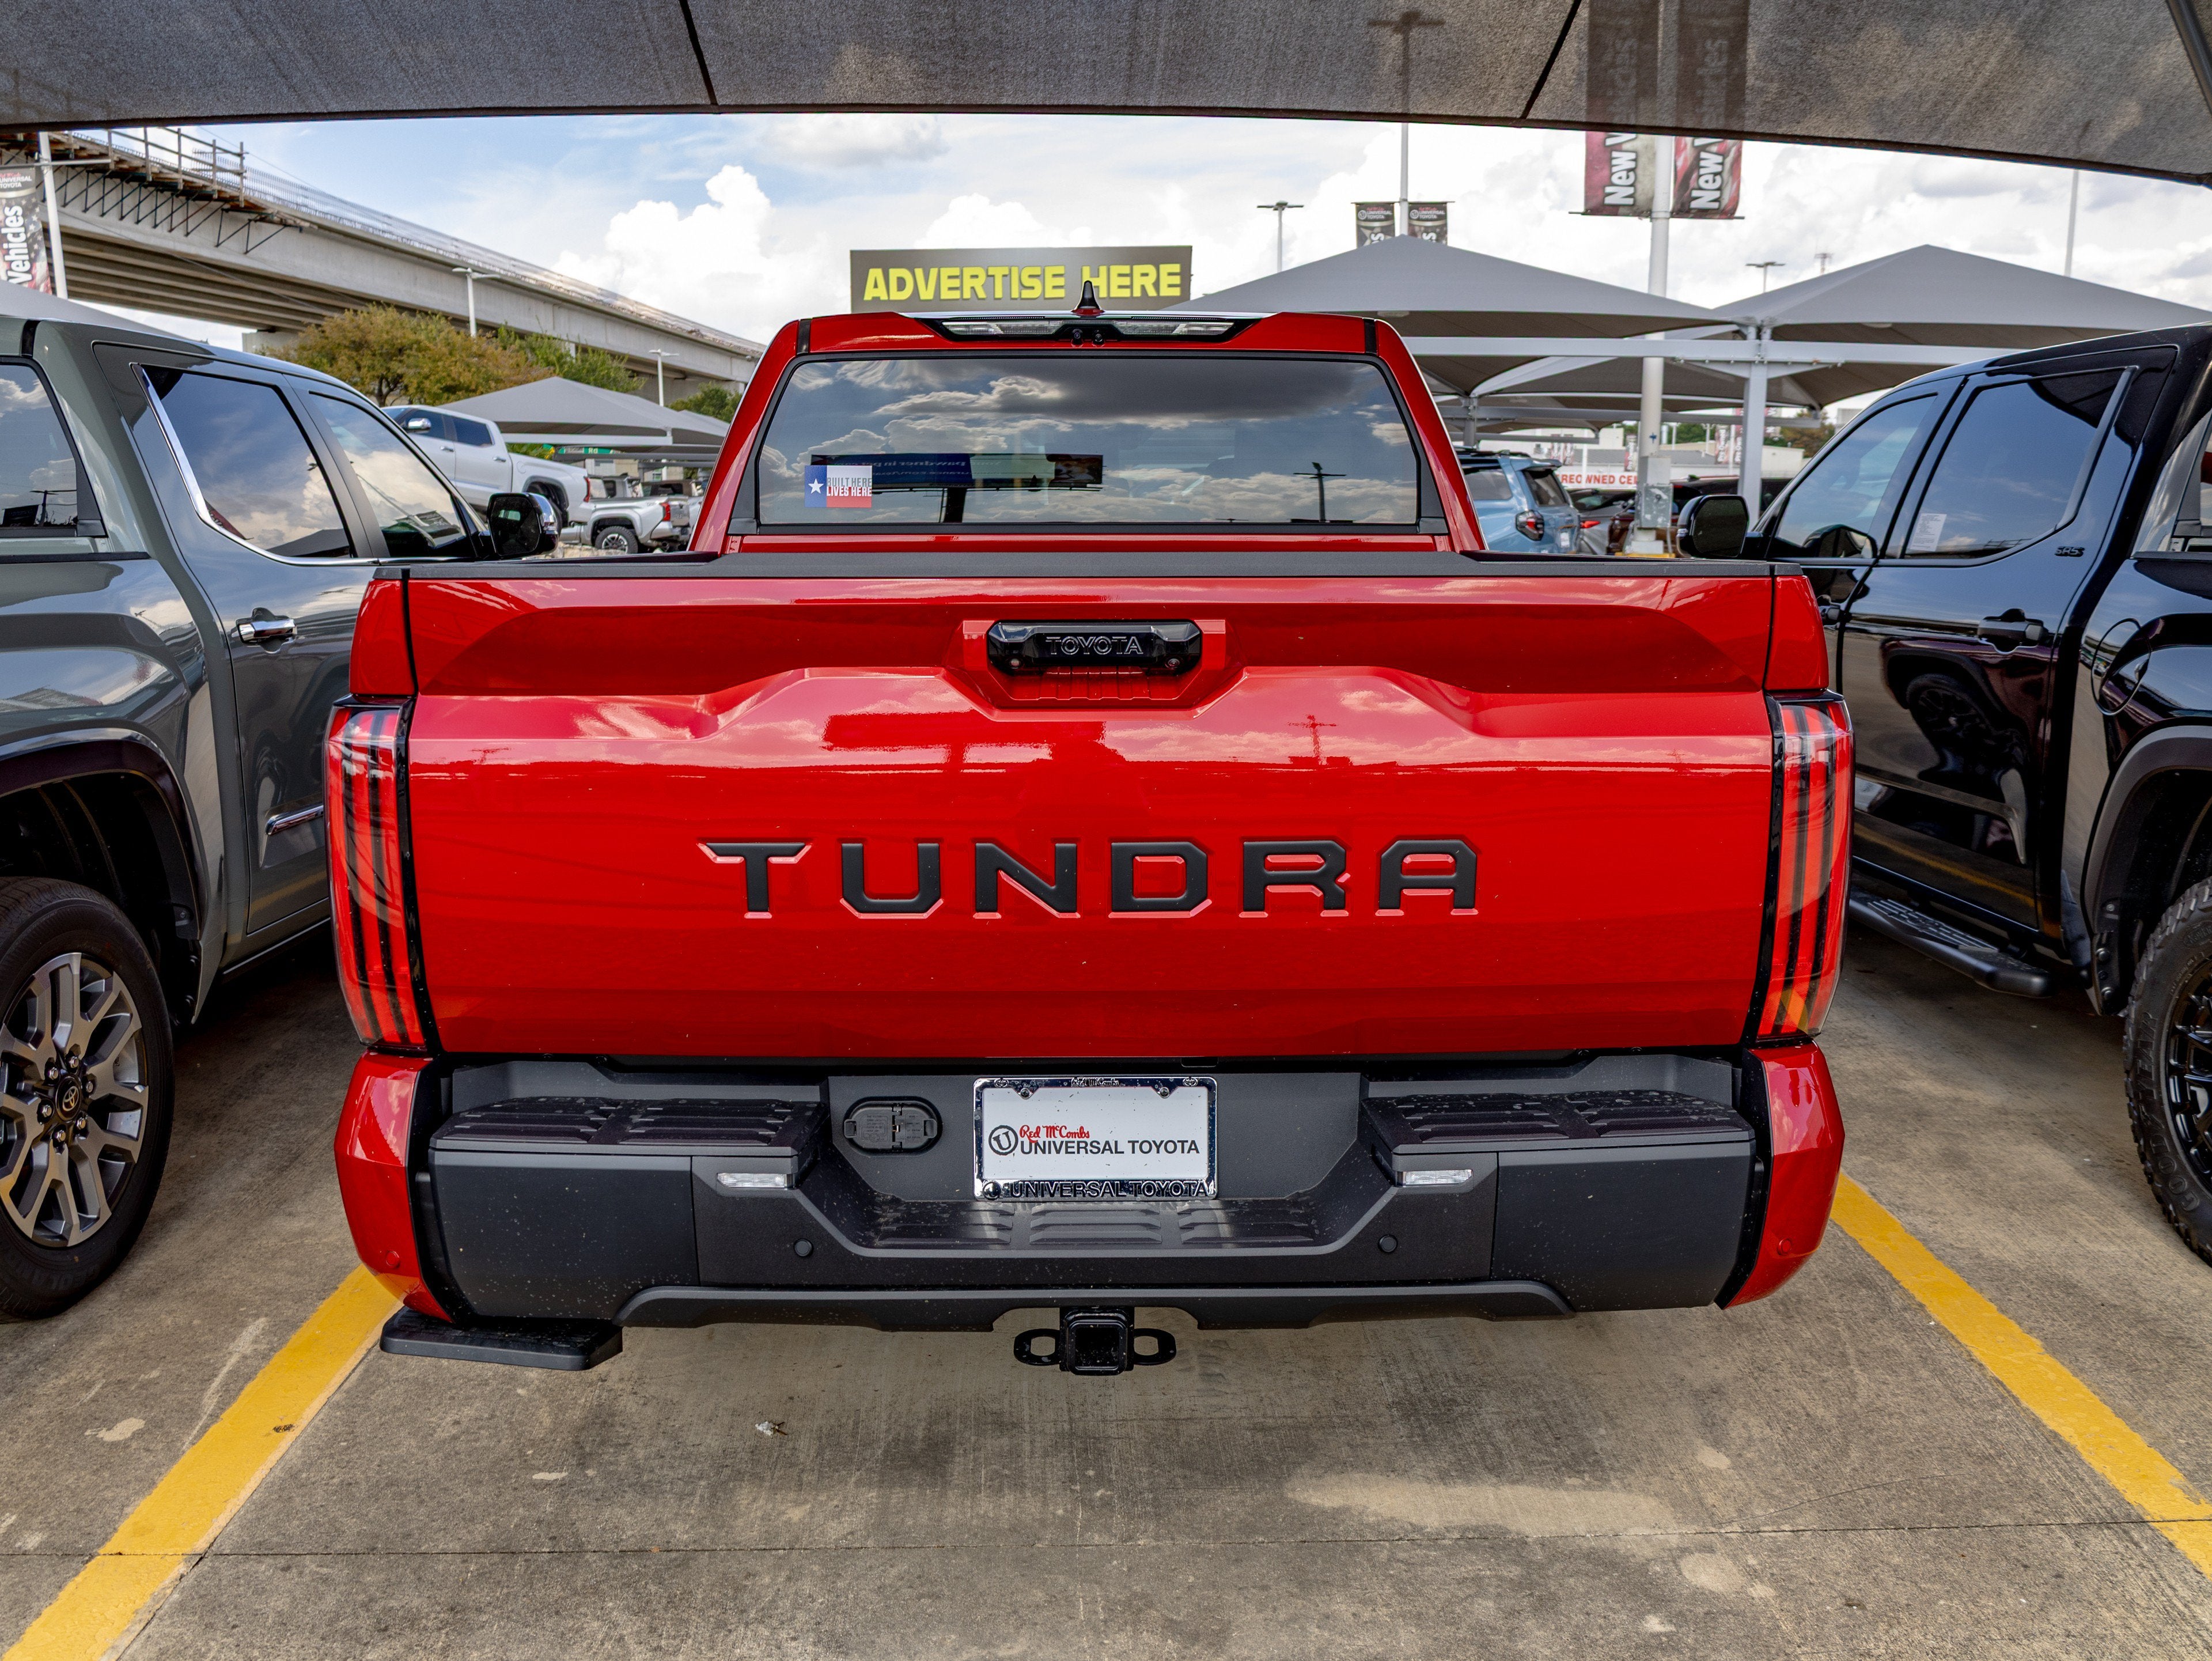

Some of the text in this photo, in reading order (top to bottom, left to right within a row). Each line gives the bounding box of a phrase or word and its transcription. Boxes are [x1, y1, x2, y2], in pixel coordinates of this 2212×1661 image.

[1604, 151, 1637, 205] New
[1690, 152, 1724, 209] New
[1, 205, 33, 285] Vehicles
[863, 263, 1181, 301] ADVERTISE HERE
[827, 477, 872, 487] BUILT HERE
[1556, 474, 1615, 484] REOWNED
[827, 486, 872, 496] LIVES HERE
[2055, 546, 2082, 557] SR5
[1046, 636, 1143, 655] TOYOTA
[698, 839, 1479, 918] TUNDRA
[1020, 1125, 1090, 1143] Red McCombs
[1020, 1139, 1200, 1155] UNIVERSAL TOYOTA
[1010, 1181, 1127, 1198] UNIVERSAL
[1130, 1181, 1209, 1197] TOYOTA
